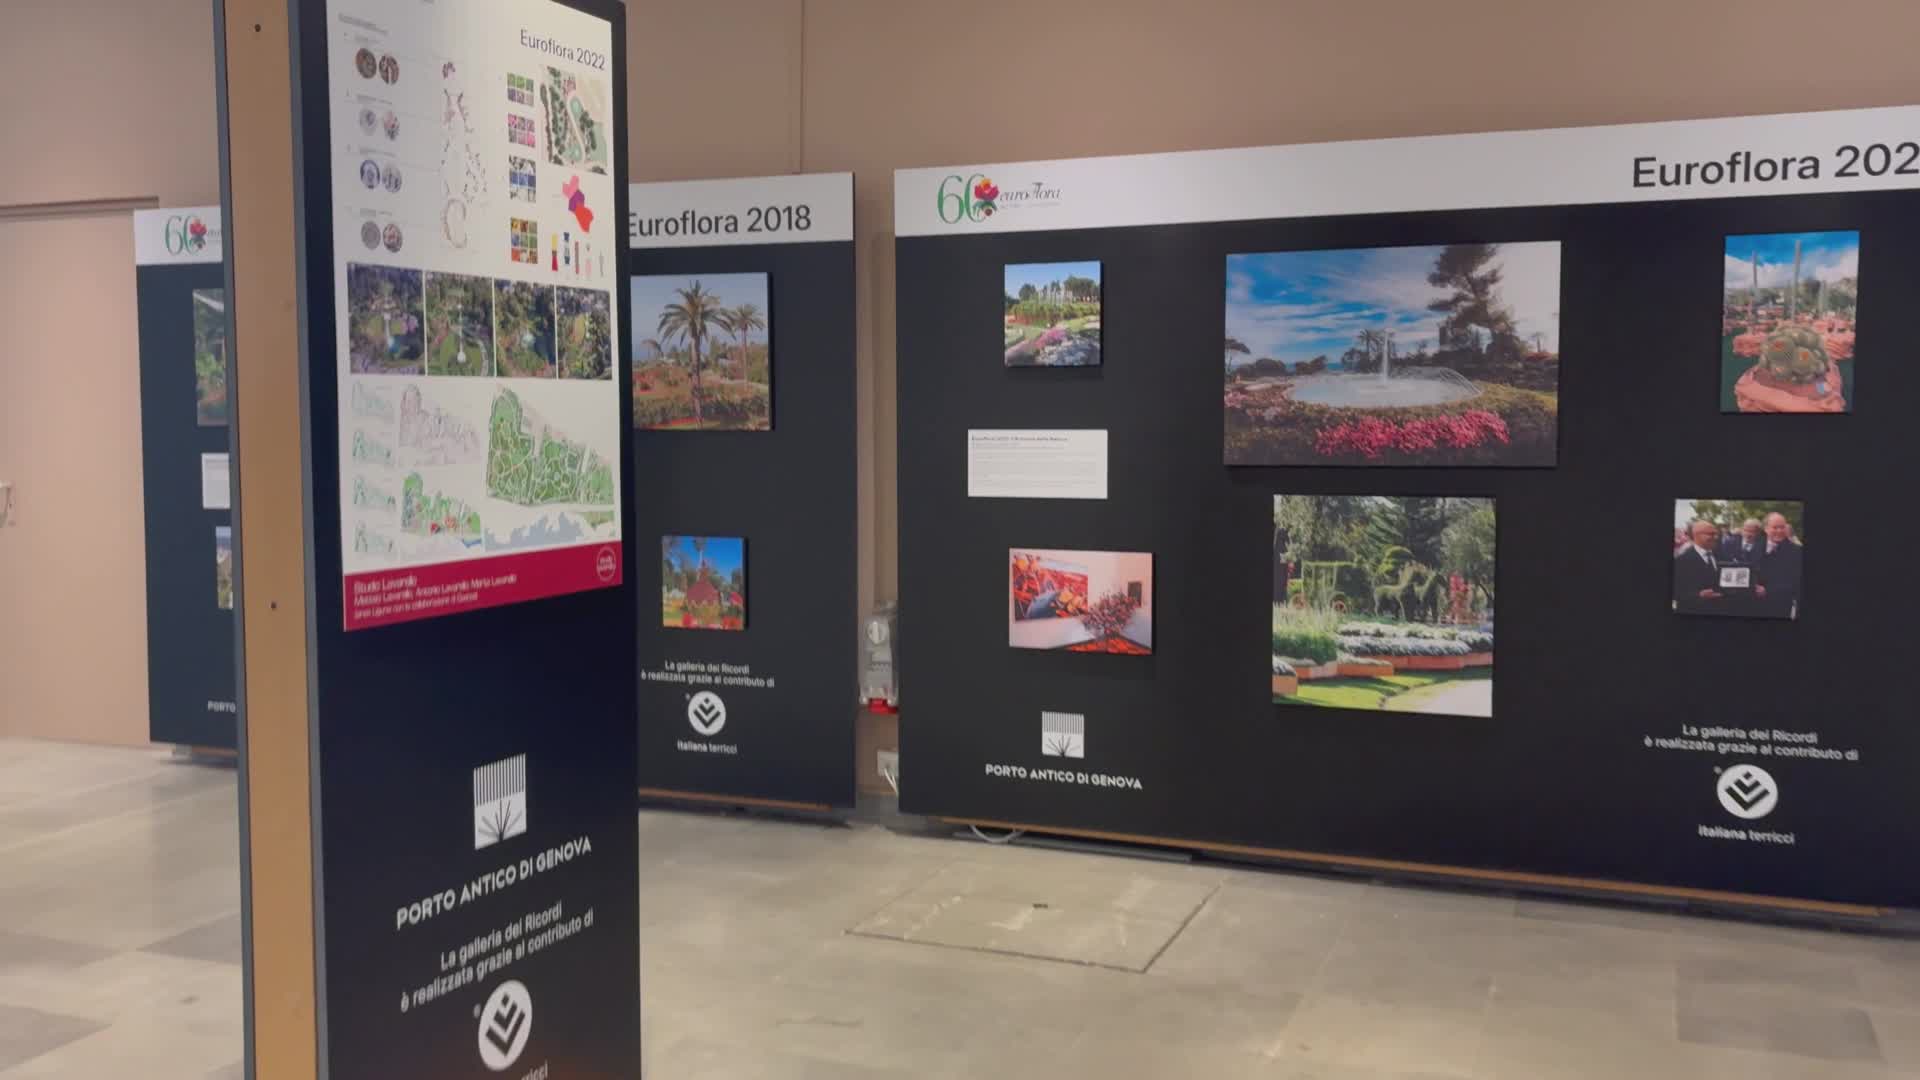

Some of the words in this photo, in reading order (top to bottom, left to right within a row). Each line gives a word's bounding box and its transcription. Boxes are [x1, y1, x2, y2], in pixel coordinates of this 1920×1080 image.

[520, 28, 574, 61] Euroflora
[576, 47, 606, 70] 2022
[1633, 151, 1820, 188] Euroflora
[746, 204, 812, 233] 2018
[648, 671, 686, 683] realizzata
[687, 673, 713, 685] grazie
[723, 676, 765, 688] contributo
[766, 677, 775, 688] di
[664, 659, 675, 671] La
[676, 662, 706, 673] galleria
[707, 663, 720, 673] dei
[721, 663, 750, 675] Ricordi
[1682, 723, 1698, 736] La
[1700, 726, 1747, 739] galleria
[1748, 729, 1769, 740] dei
[1772, 729, 1818, 744] Ricordi
[709, 742, 738, 755] terricci
[1644, 735, 1653, 748] è
[1655, 737, 1715, 752] realizzata
[1717, 742, 1758, 755] grazie
[1760, 744, 1772, 756] al
[1773, 745, 1843, 760] contributo
[1844, 748, 1859, 761] di
[985, 763, 1027, 778] PORTO
[1029, 768, 1075, 783] ANTICO
[1076, 772, 1089, 785] DI
[1091, 773, 1143, 790] GENOVA
[1748, 829, 1795, 845] terricci
[396, 889, 456, 930] PORTO
[459, 865, 517, 905] ANTICO
[519, 856, 534, 881] DI
[536, 835, 592, 873] GENOVA
[440, 951, 456, 972] La
[459, 929, 502, 967] galleria
[504, 917, 523, 943] dei
[525, 899, 562, 933] Ricordi
[400, 991, 410, 1013] è
[413, 966, 474, 1008] realizzata
[476, 946, 513, 982] grazie
[515, 938, 525, 961] al
[528, 916, 582, 954] contributo
[583, 906, 594, 928] di
